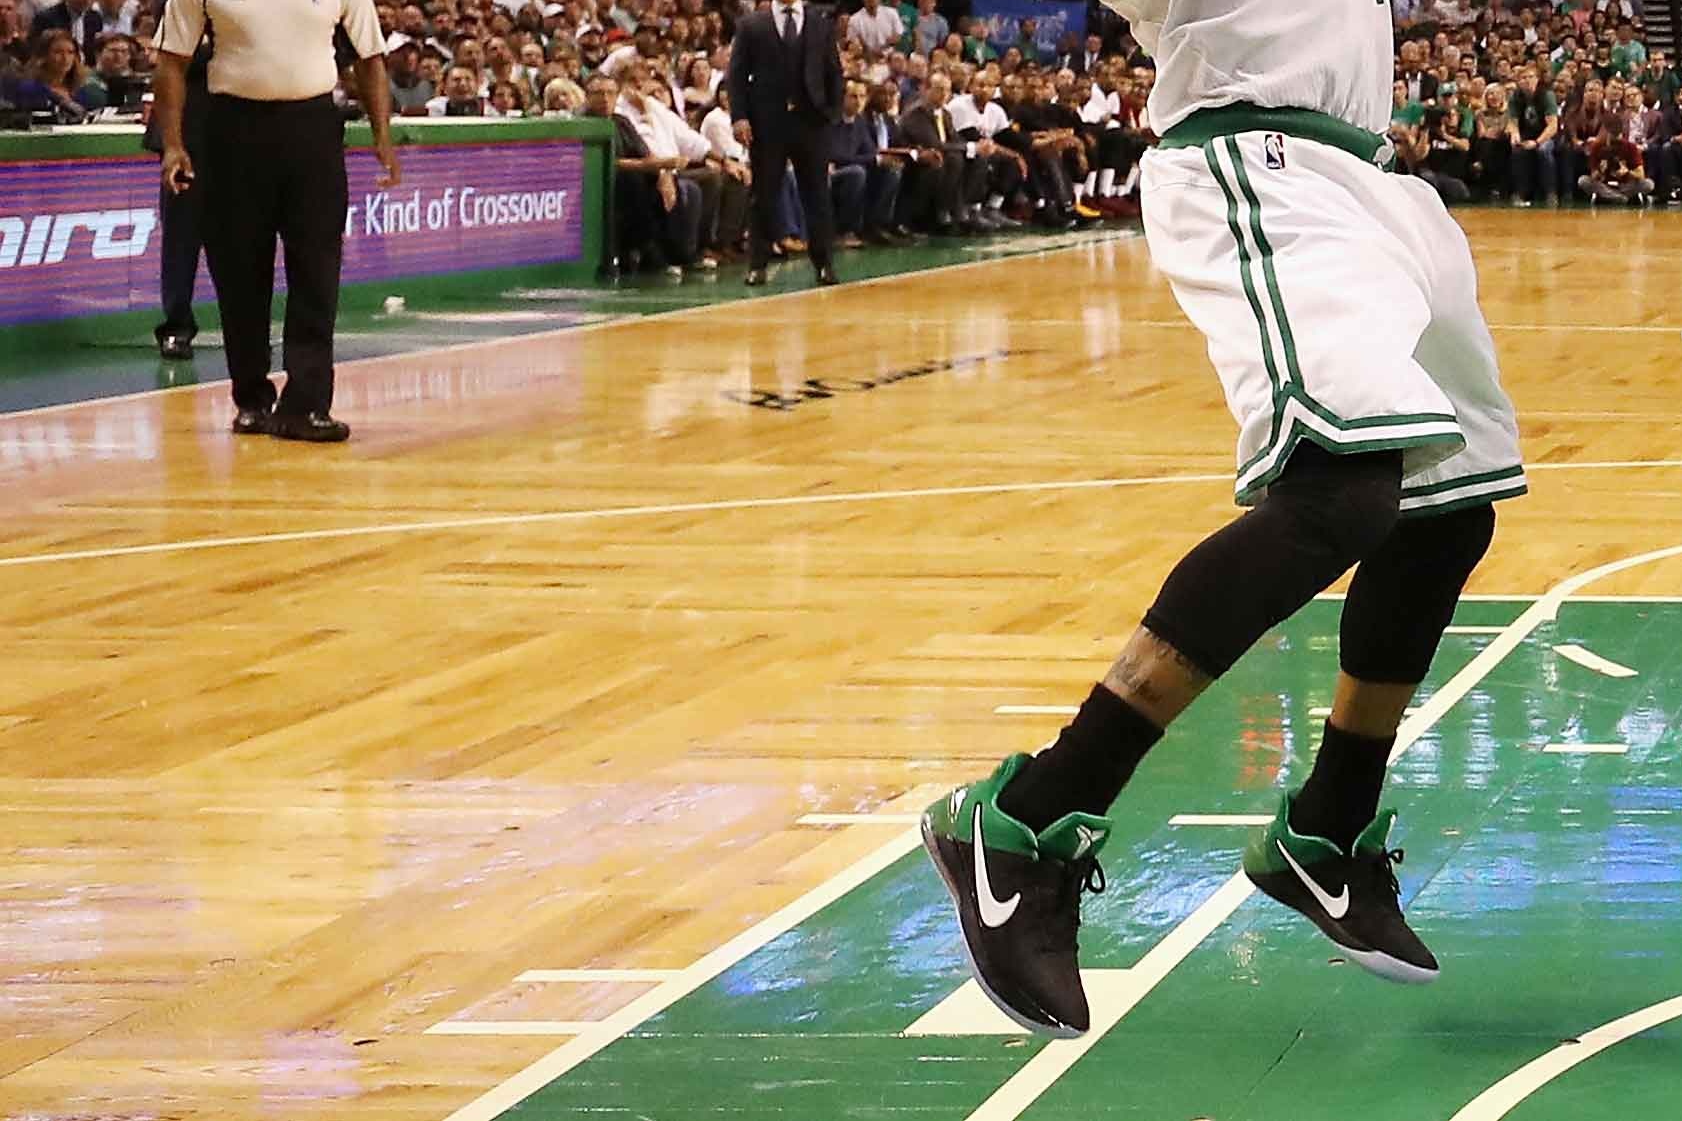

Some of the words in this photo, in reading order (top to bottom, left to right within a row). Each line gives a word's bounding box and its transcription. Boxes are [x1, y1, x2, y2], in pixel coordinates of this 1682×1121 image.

[365, 189, 420, 235] Kind
[427, 187, 454, 230] of
[459, 186, 566, 228] Crossover
